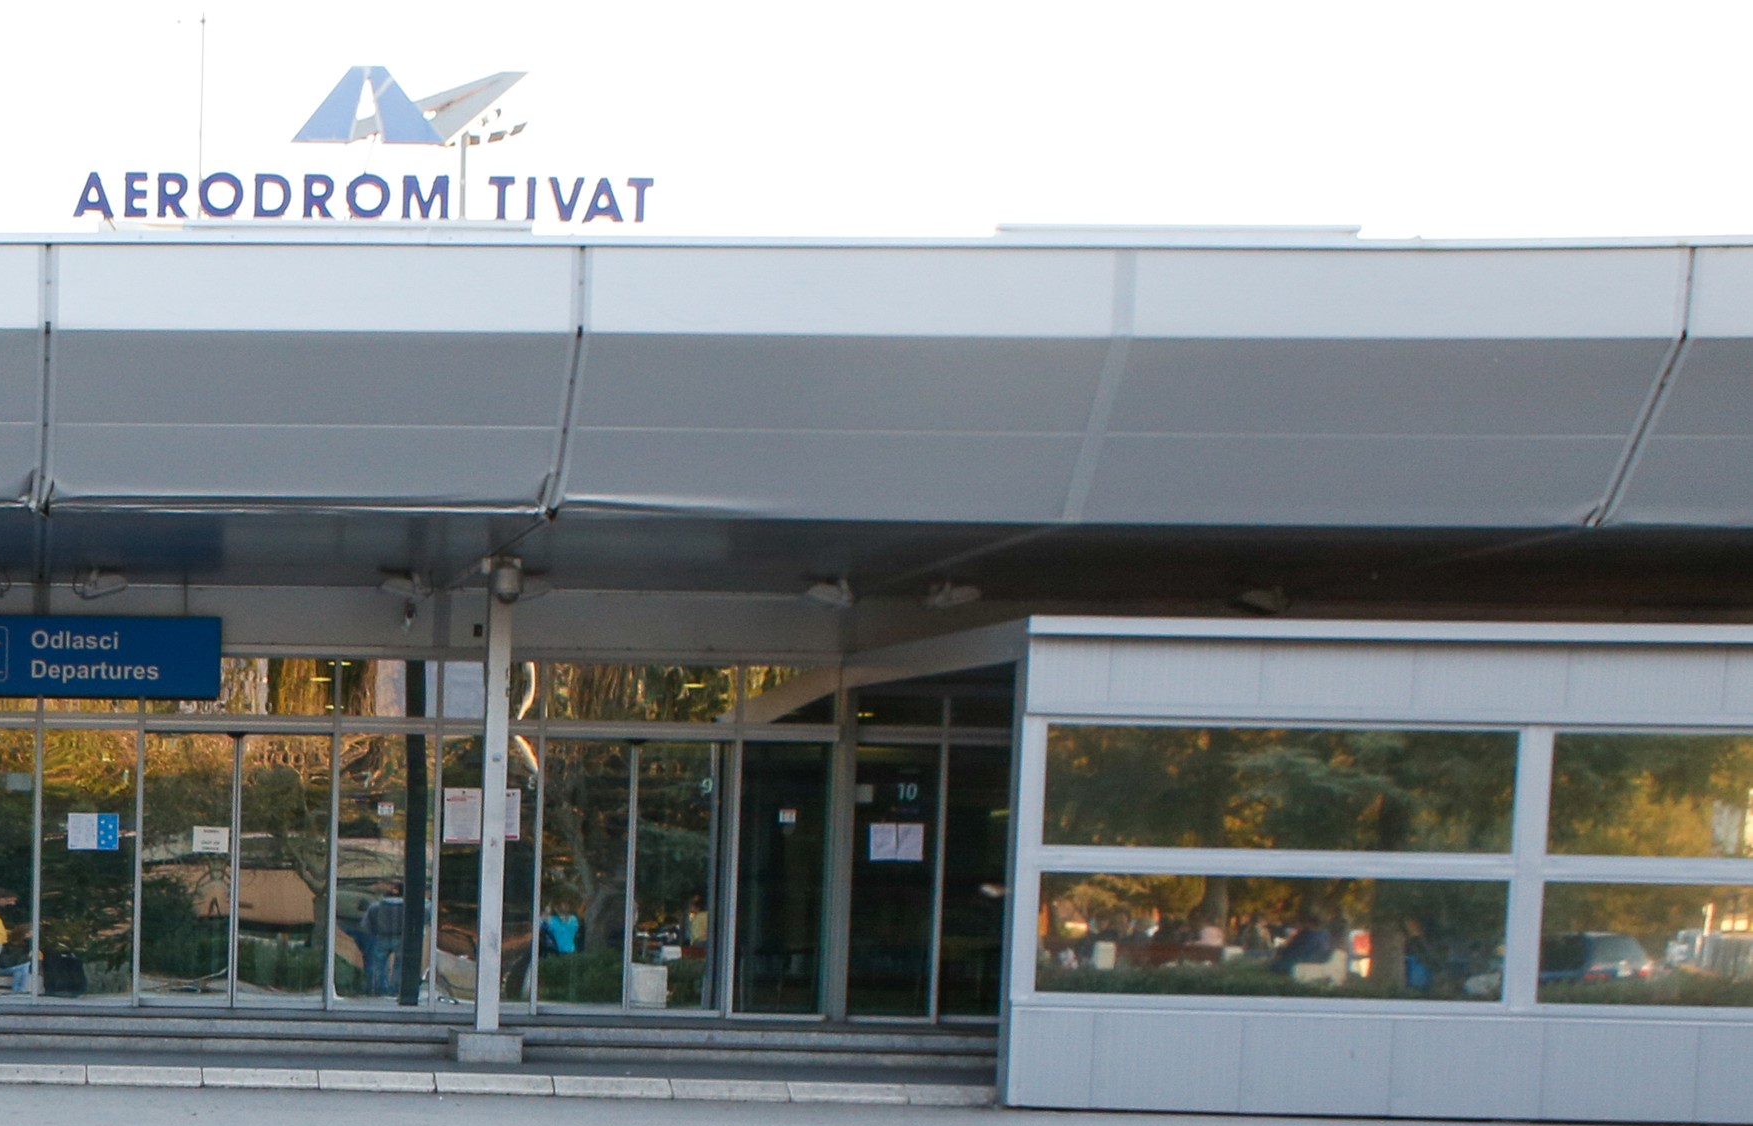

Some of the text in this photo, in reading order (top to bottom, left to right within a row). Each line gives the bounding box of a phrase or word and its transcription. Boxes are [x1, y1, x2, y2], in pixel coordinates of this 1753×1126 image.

[73, 171, 654, 223] AERODROM TIVAT
[31, 629, 120, 650] Odlasci
[31, 659, 160, 684] Departures
[700, 777, 714, 794] 9
[897, 782, 918, 801] 10
